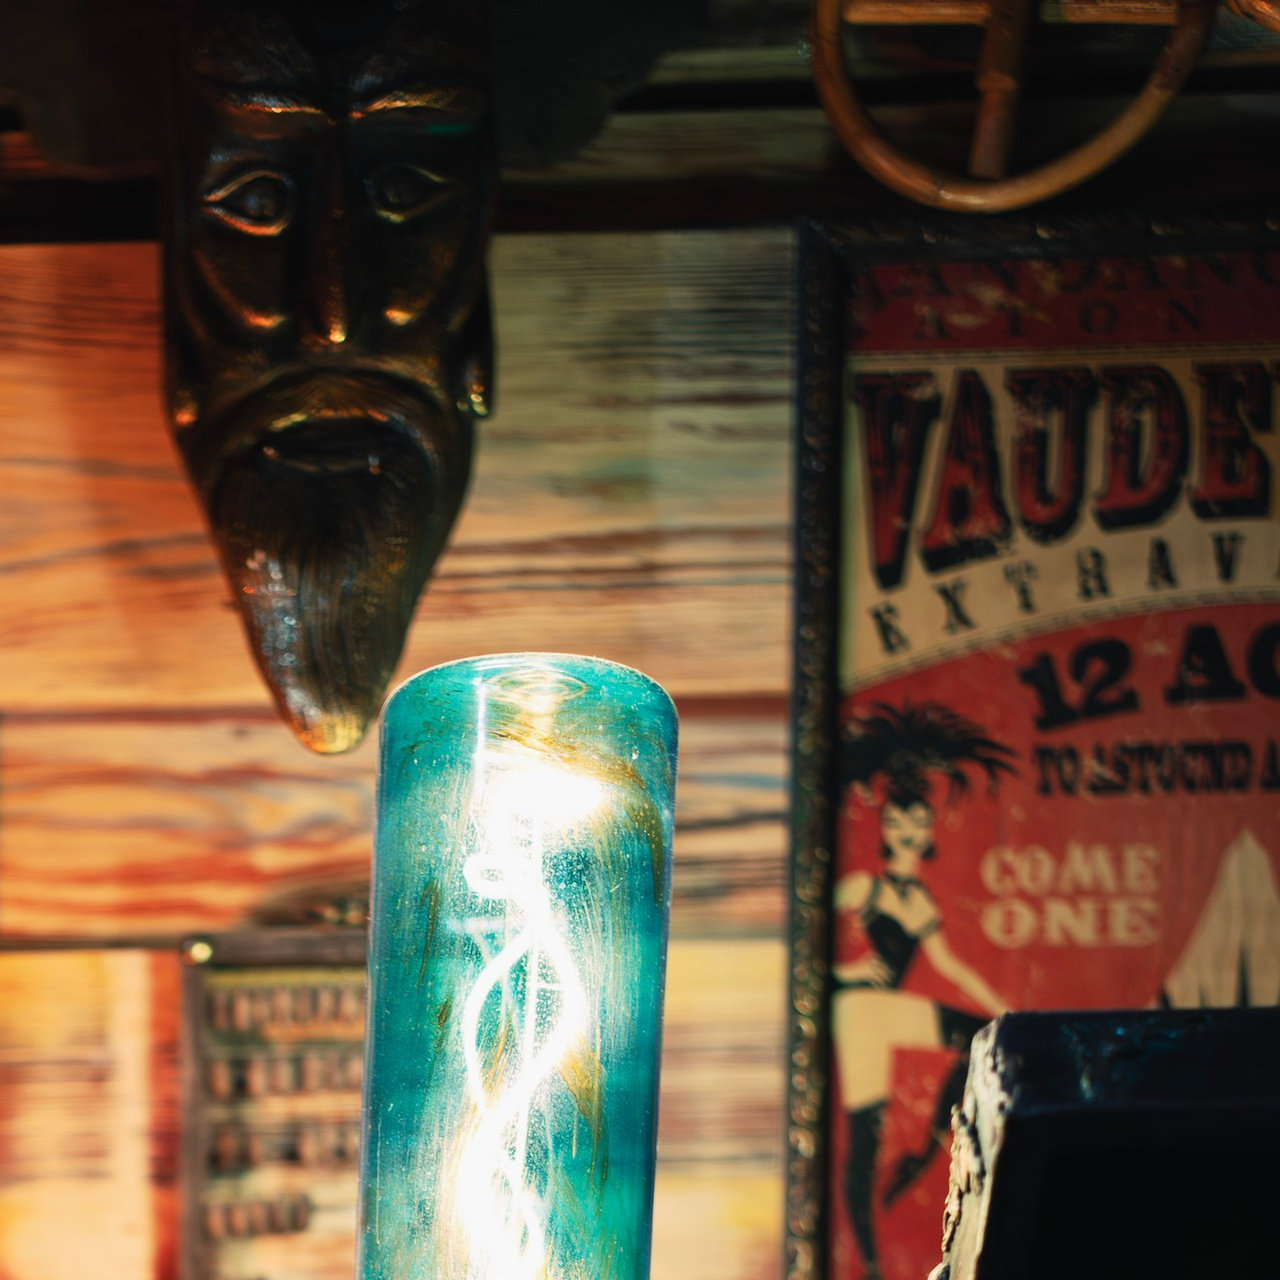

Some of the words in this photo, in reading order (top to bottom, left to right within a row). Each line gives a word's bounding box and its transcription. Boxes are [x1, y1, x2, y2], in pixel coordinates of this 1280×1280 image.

[853, 359, 1280, 592] VAUDE
[870, 531, 1280, 655] EXTRAV
[1021, 637, 1139, 732] 12
[1032, 743, 1079, 797] TO
[1085, 739, 1253, 797] ASTOUND
[980, 839, 1161, 897] COME
[980, 896, 1160, 950] ONE
